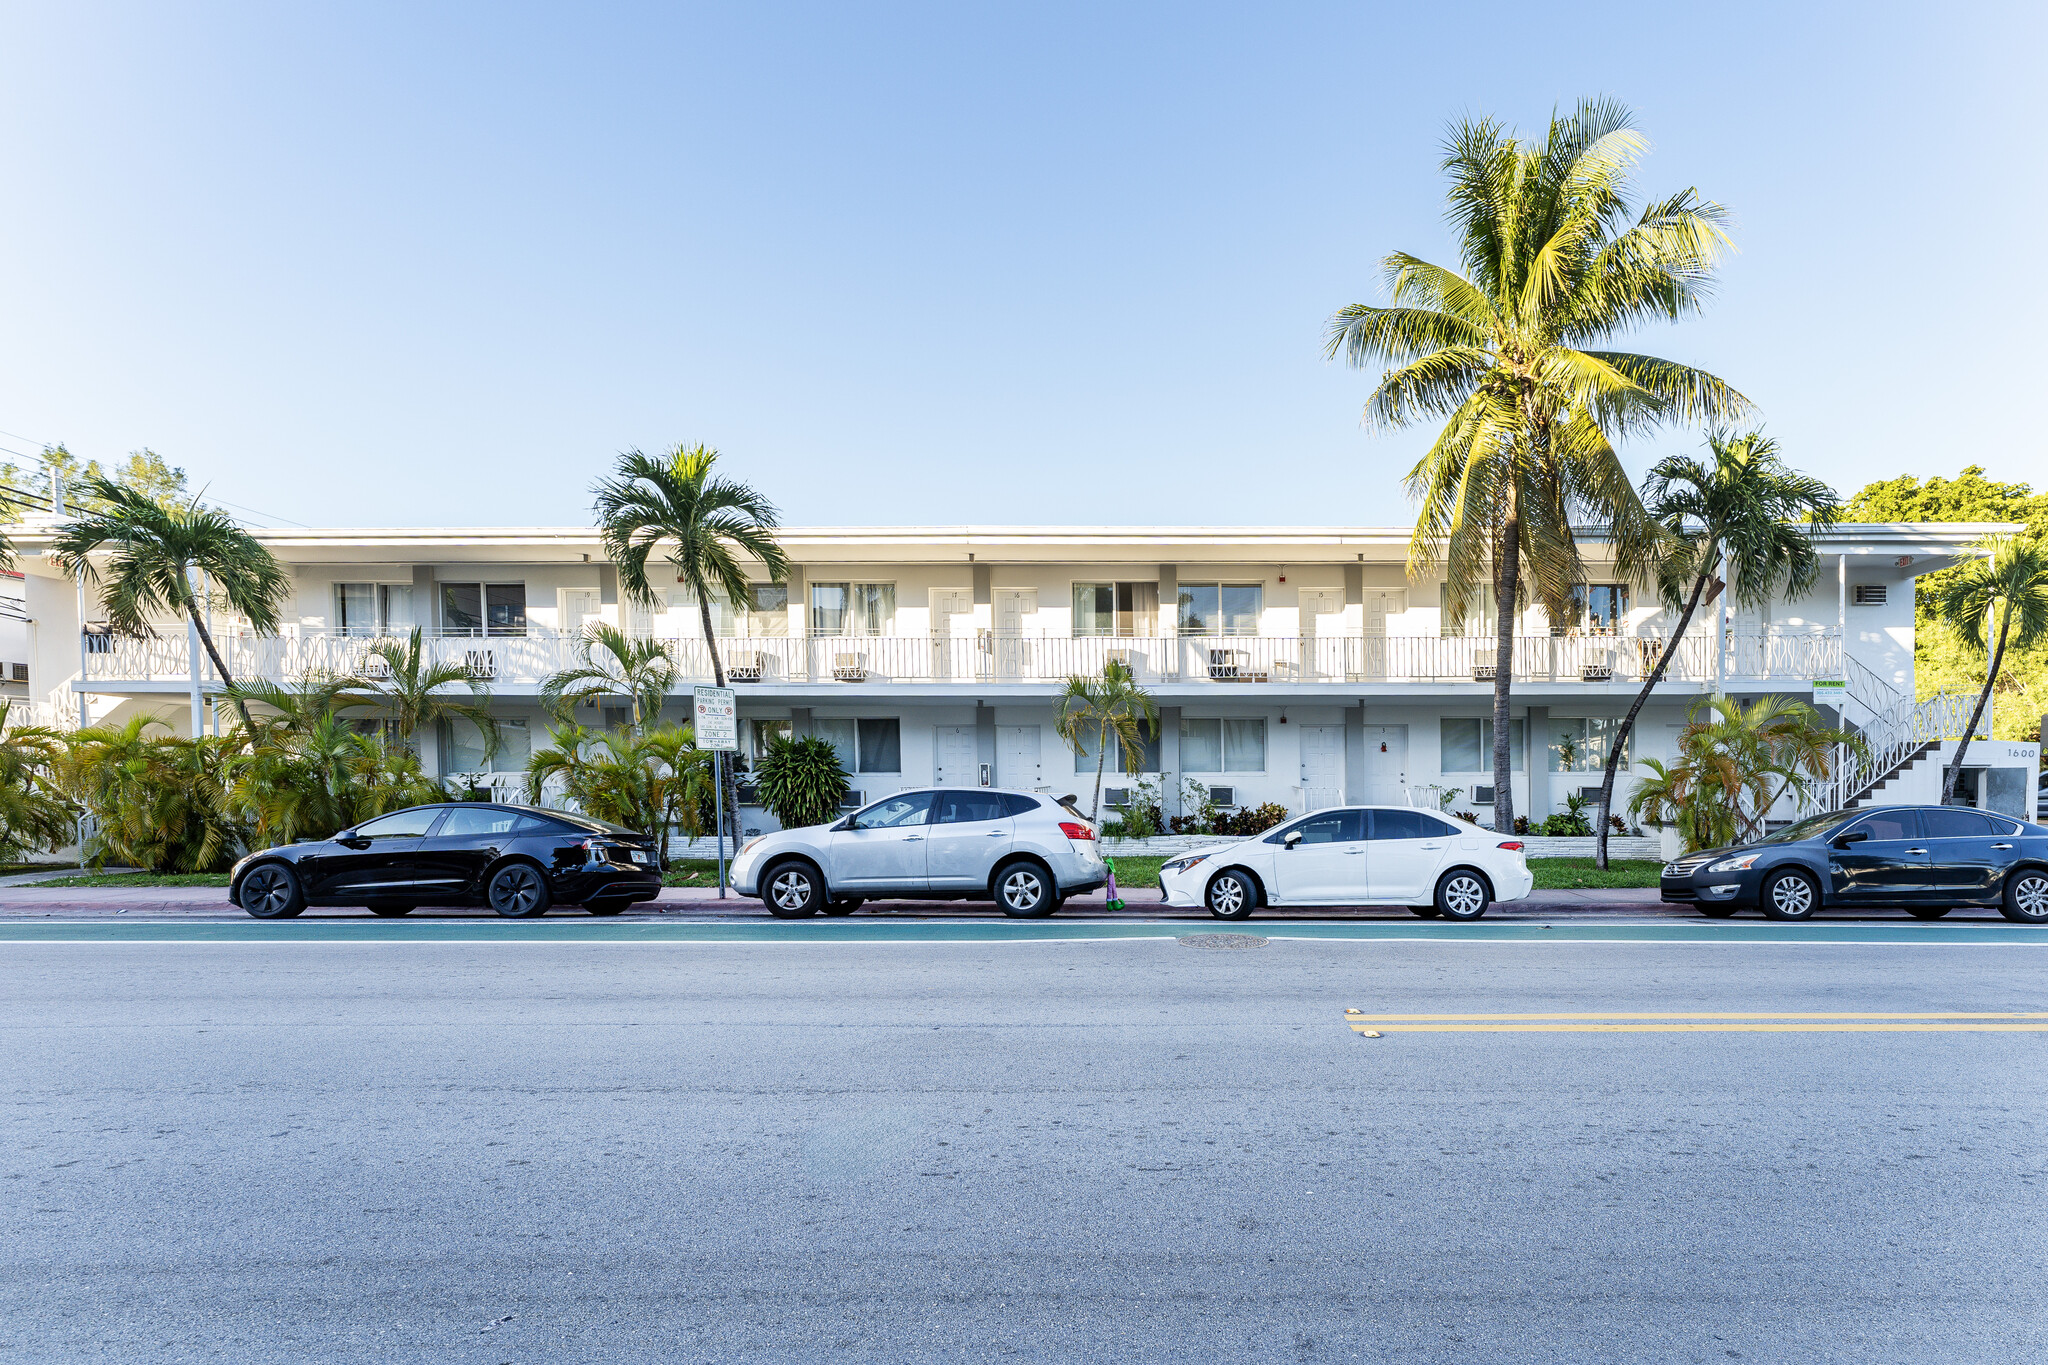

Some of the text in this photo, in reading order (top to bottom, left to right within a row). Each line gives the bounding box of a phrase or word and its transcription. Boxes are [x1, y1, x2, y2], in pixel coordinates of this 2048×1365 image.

[697, 689, 732, 698] RESIDENTIAL
[697, 697, 715, 705] PARKING
[2008, 749, 2035, 758] 1600
